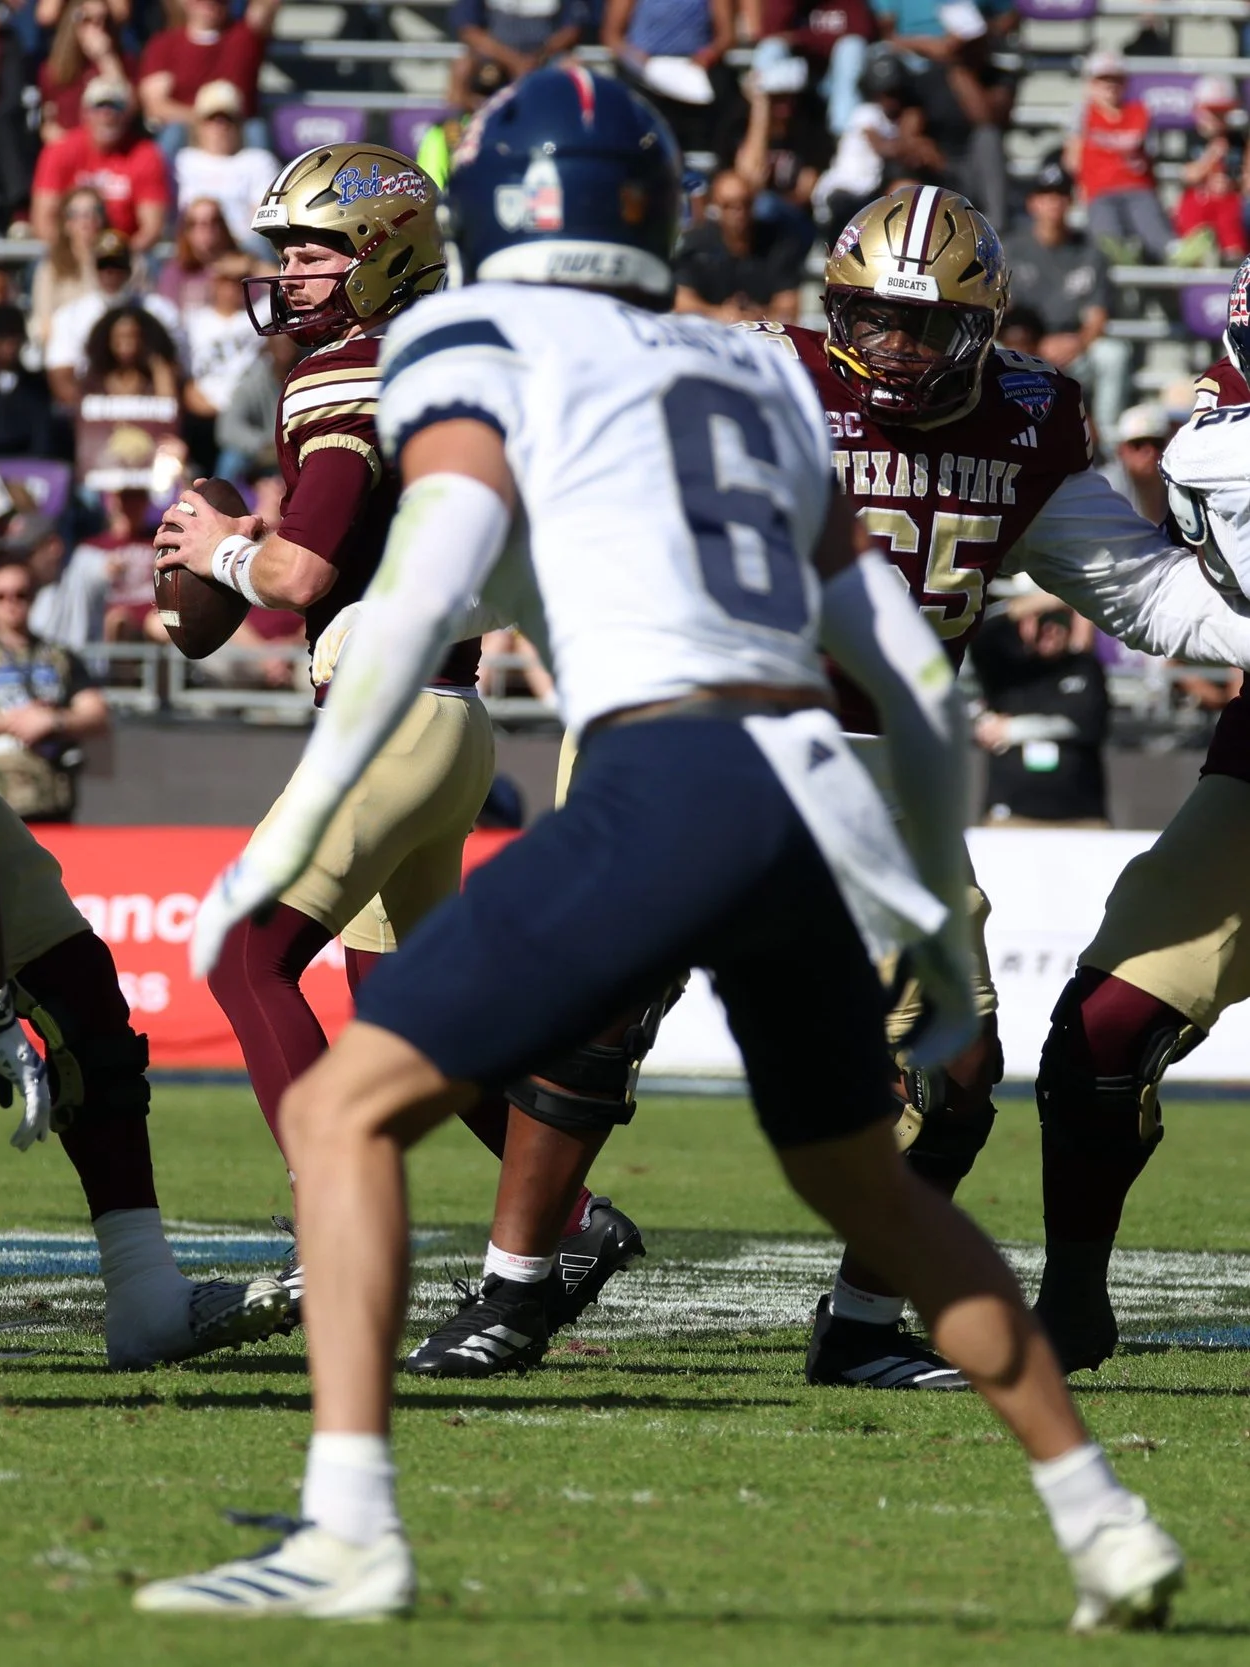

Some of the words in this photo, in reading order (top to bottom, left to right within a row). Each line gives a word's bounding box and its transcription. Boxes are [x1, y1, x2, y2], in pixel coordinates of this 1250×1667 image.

[887, 277, 927, 292] BOBCATS
[824, 411, 863, 438] BC
[830, 451, 929, 499] TEXAS
[938, 453, 1023, 505] STATE
[658, 372, 812, 637] 6
